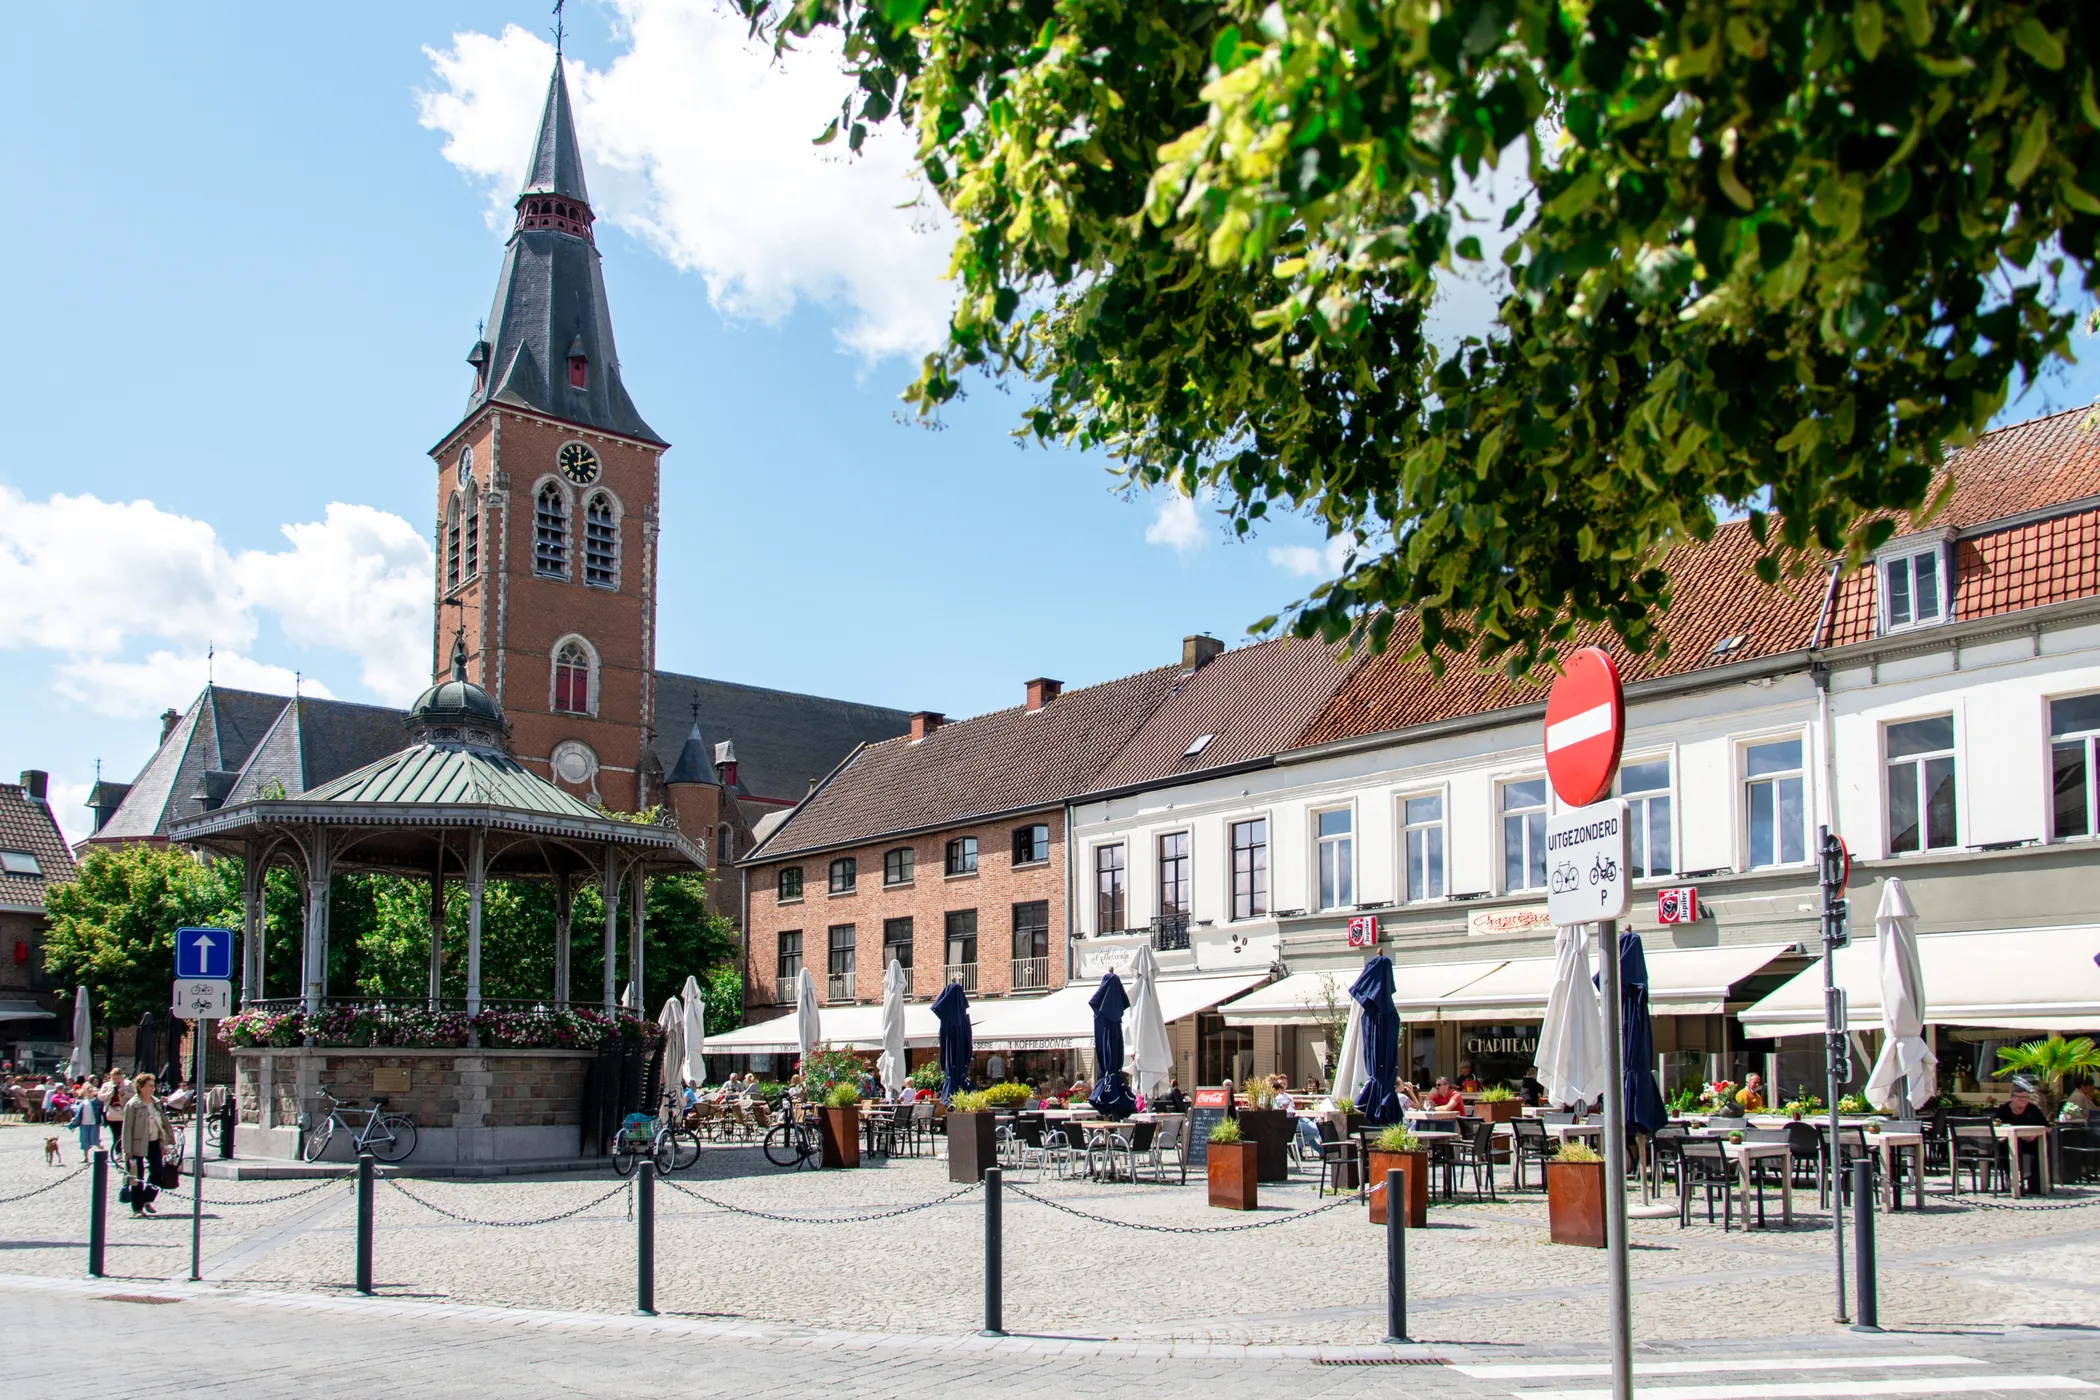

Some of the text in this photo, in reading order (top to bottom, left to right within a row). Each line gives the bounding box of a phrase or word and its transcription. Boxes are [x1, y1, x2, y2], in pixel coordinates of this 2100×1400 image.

[1548, 818, 1618, 851] UITGEZONDERD
[1601, 889, 1608, 906] P
[1680, 890, 1689, 920] Jupiler
[1014, 1038, 1073, 1050] KOFFIEBOONTJE
[1468, 1037, 1537, 1054] CHAPITEAU
[1197, 1092, 1225, 1104] Coca-Cola
